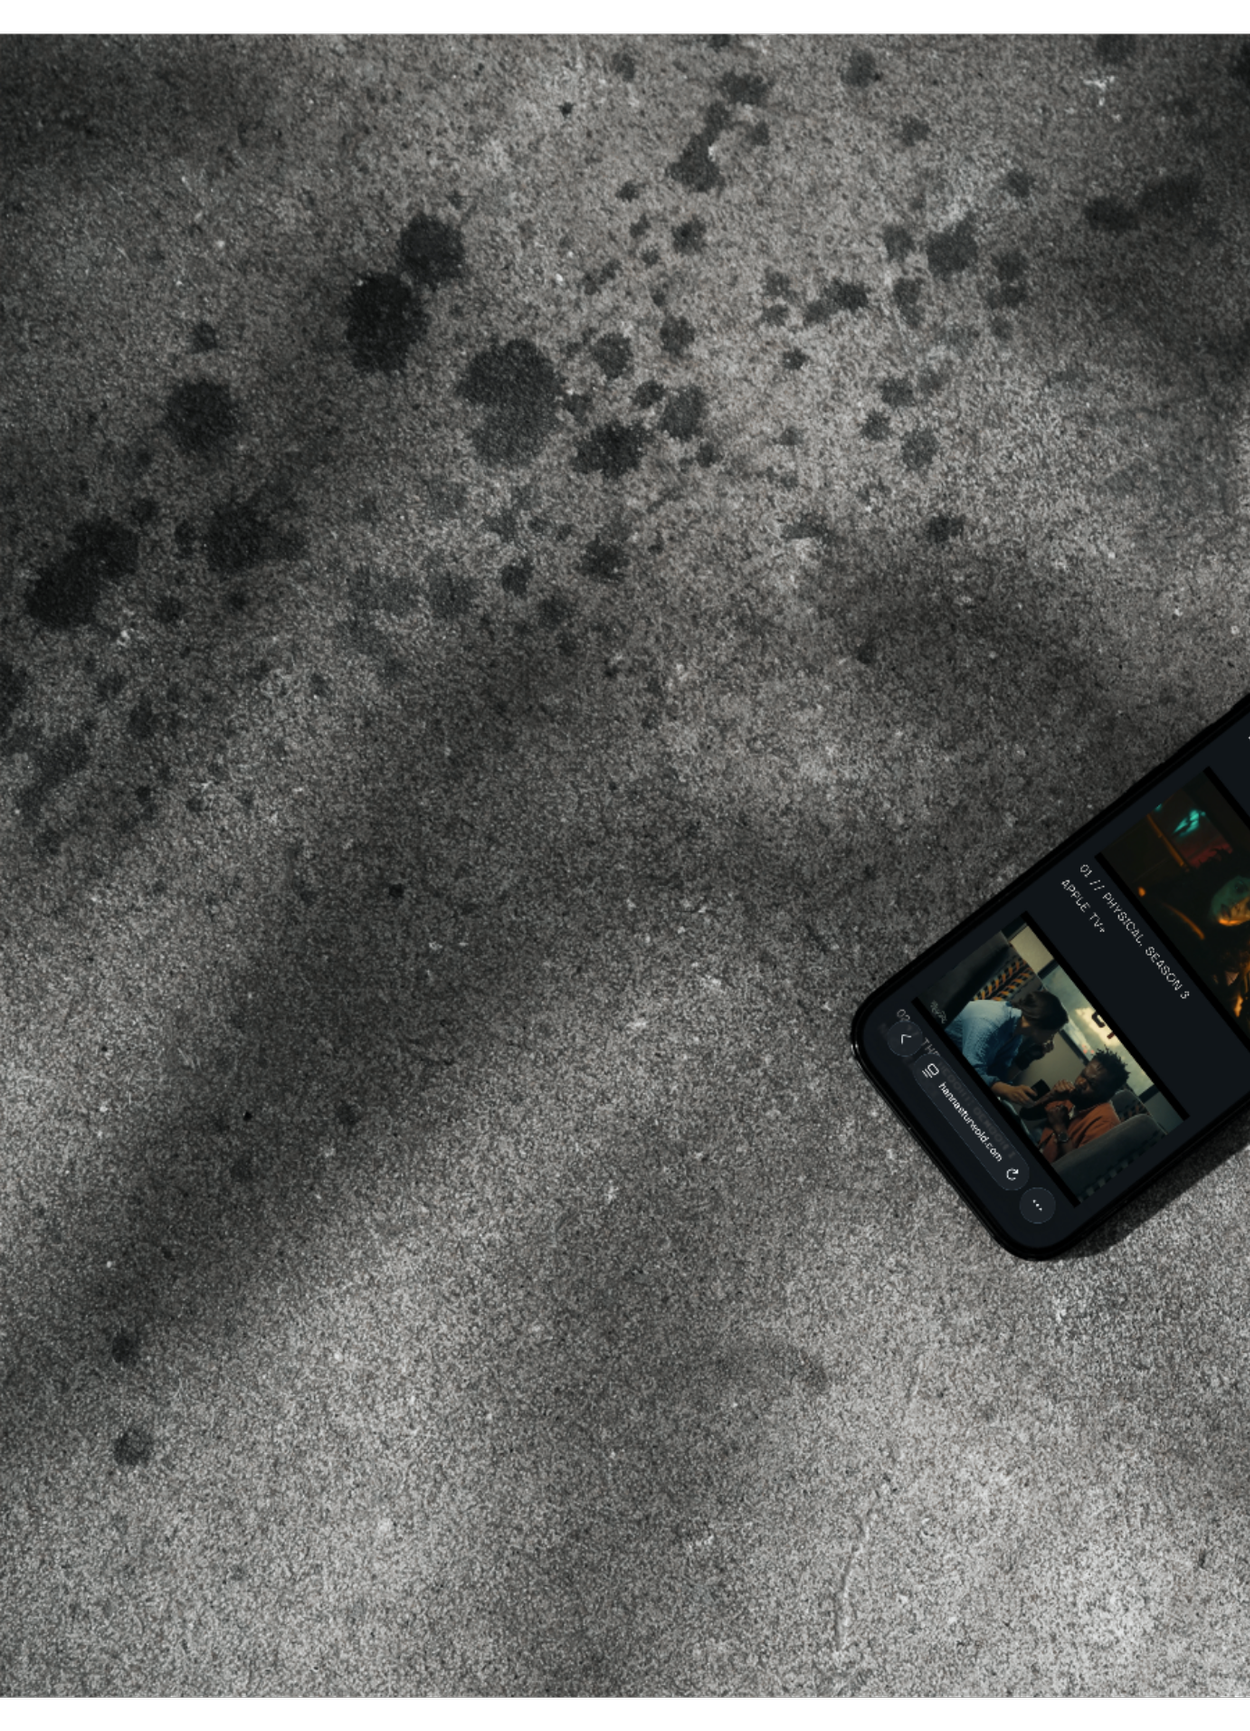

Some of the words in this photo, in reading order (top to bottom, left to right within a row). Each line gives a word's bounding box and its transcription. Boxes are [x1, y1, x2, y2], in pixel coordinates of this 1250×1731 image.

[1061, 879, 1091, 912] APPLE
[1089, 912, 1105, 933] TV+
[1080, 864, 1093, 878] 01
[1145, 946, 1183, 991] SEASON
[1180, 991, 1190, 999] 3
